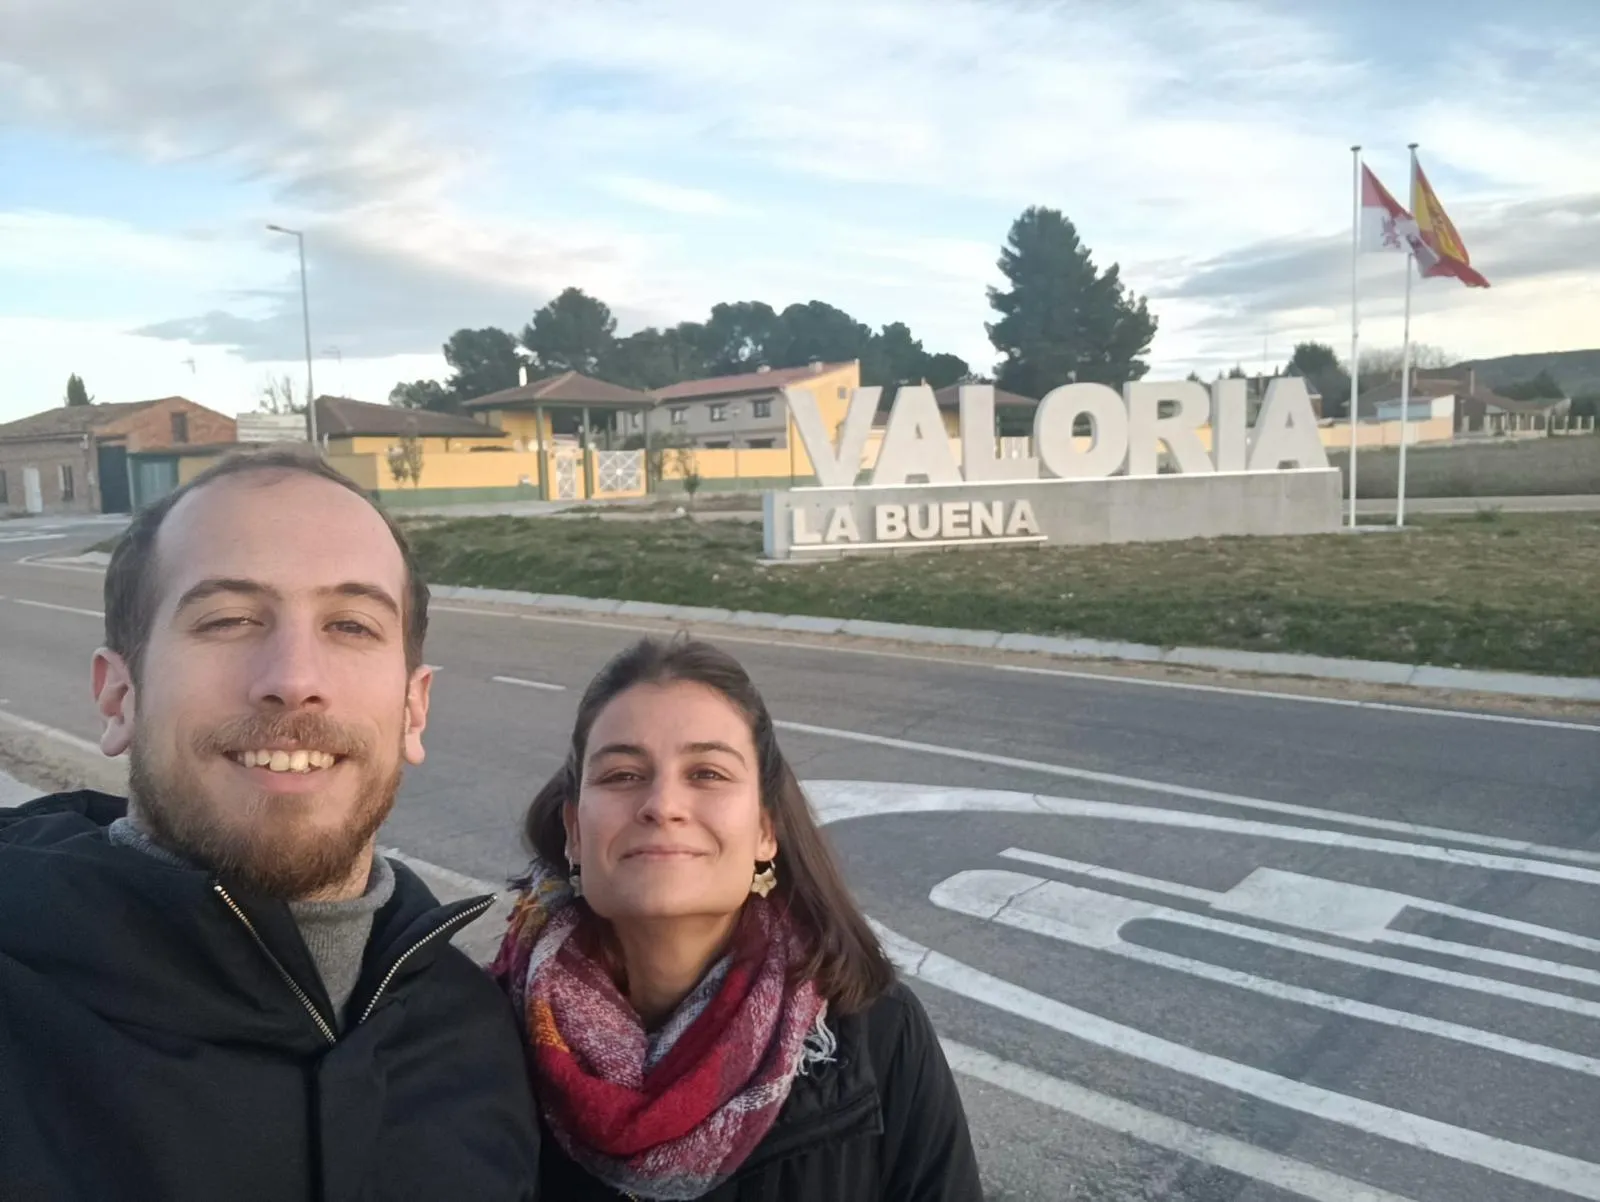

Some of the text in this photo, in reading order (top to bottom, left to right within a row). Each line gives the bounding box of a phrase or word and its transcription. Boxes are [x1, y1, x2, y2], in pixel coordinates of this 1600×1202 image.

[784, 377, 1332, 487] VALORIA
[792, 500, 1041, 543] LA BUENA
